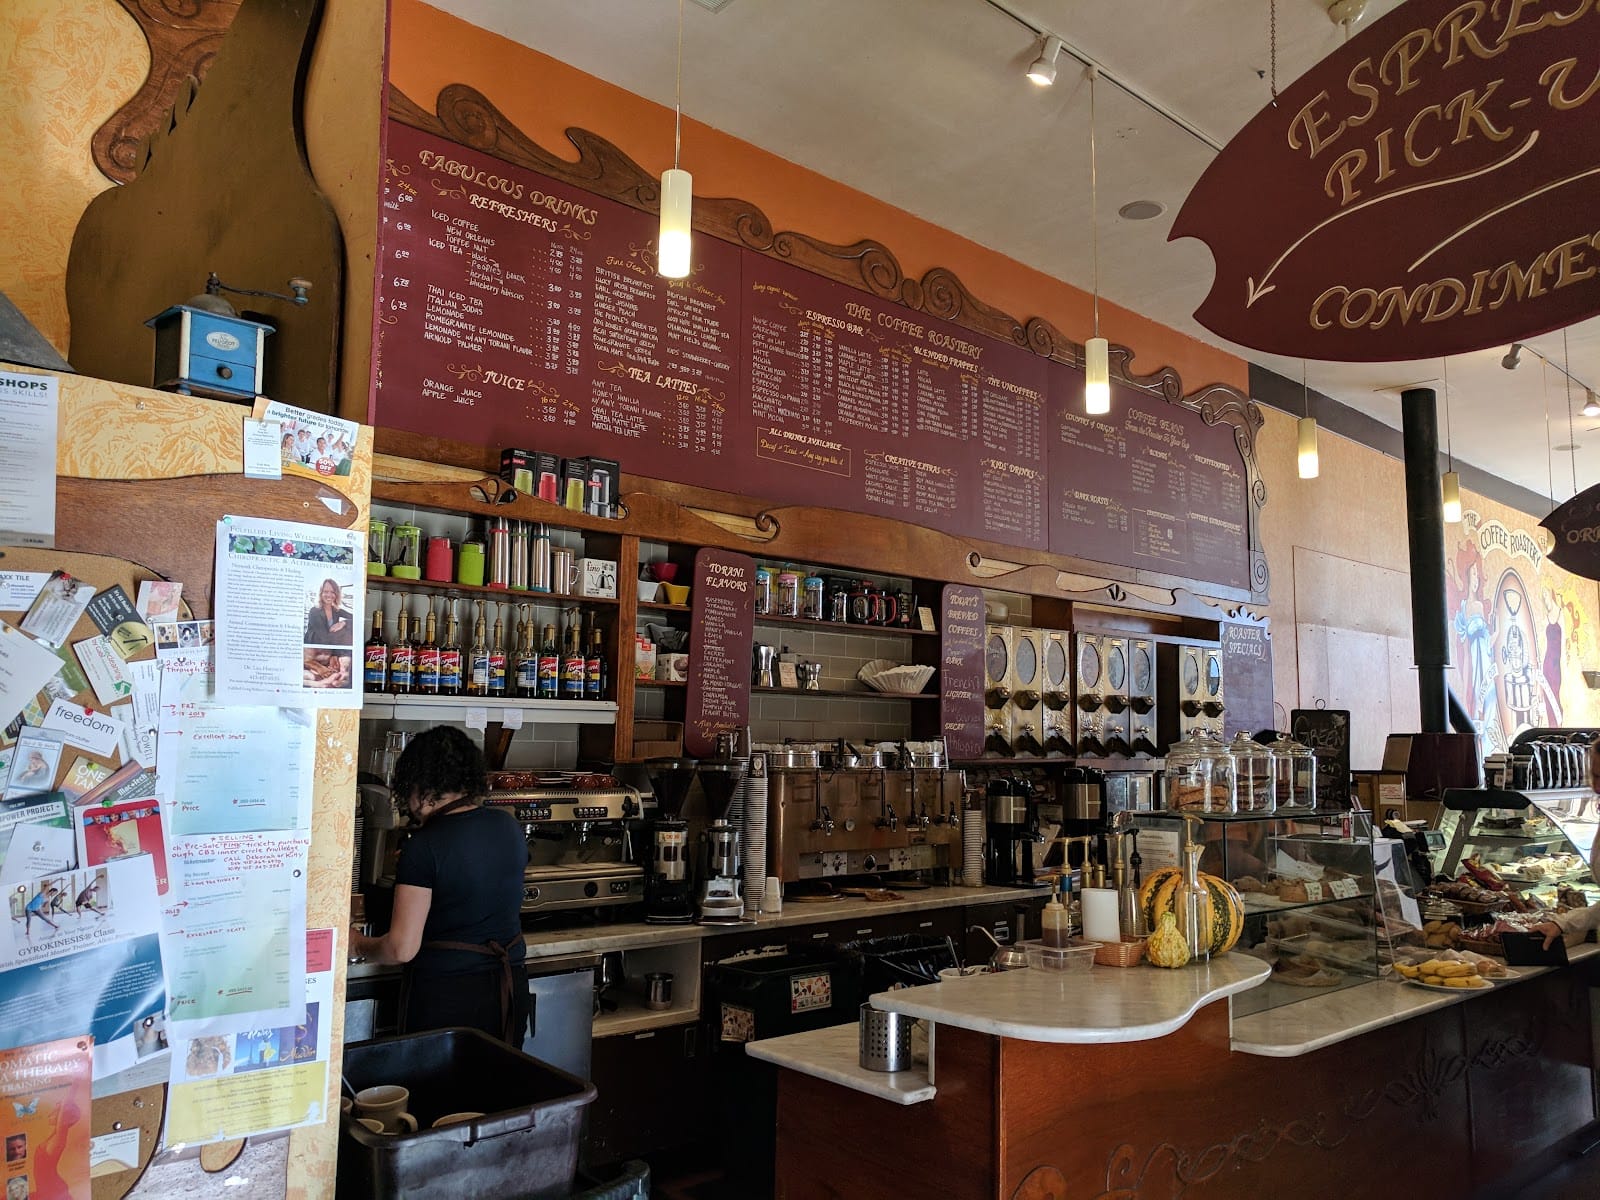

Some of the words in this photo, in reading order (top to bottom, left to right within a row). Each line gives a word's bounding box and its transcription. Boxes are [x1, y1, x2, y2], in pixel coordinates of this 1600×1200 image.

[419, 149, 525, 200] FABULOUS
[528, 189, 599, 226] DRINKS
[431, 209, 449, 222] ICED
[452, 218, 480, 232] COFFEE
[468, 193, 559, 234] REFRESHERS
[445, 234, 470, 249] TOFFEE
[473, 242, 489, 255] NUT
[446, 225, 462, 237] NEW
[465, 230, 496, 247] ORLEANS
[429, 237, 446, 250] ICED
[449, 244, 463, 257] TEA
[470, 269, 493, 283] herbal
[1309, 231, 1600, 330] CONDIME
[426, 294, 457, 310] ITALIAN
[428, 284, 445, 297] THAI
[448, 290, 466, 302] ICED
[469, 296, 484, 307] TEA
[426, 304, 465, 320] LEMONADE
[424, 322, 463, 339] LEMONADE
[805, 309, 846, 330] ESPRESSO
[846, 321, 865, 337] BAR
[845, 302, 872, 322] THE
[877, 312, 925, 340] COFFEE
[927, 330, 984, 361] ROASTERY
[913, 346, 948, 364] BLENDED
[423, 378, 455, 394] ORANGE
[483, 370, 526, 391] JUICE
[609, 383, 623, 393] TEA
[627, 367, 651, 384] TEA
[655, 375, 698, 396] LATTES
[422, 388, 447, 400] APPLE
[271, 410, 298, 422] brighter
[298, 416, 318, 427] future
[285, 406, 306, 418] Better
[769, 428, 783, 437] ALL
[783, 431, 808, 443] DRINKS
[807, 437, 842, 451] AVAILABLE
[1480, 524, 1508, 550] COFFEE
[1510, 534, 1541, 568] ROASTERY
[708, 563, 745, 578] TORANI
[705, 576, 748, 593] FLAVORS
[1228, 626, 1263, 643] ROASTER
[1227, 641, 1264, 658] SPECIALS
[55, 705, 116, 736] freedom
[77, 765, 106, 784] ONE
[26, 804, 55, 817] PROJECT
[12, 1058, 82, 1081] THERAPY
